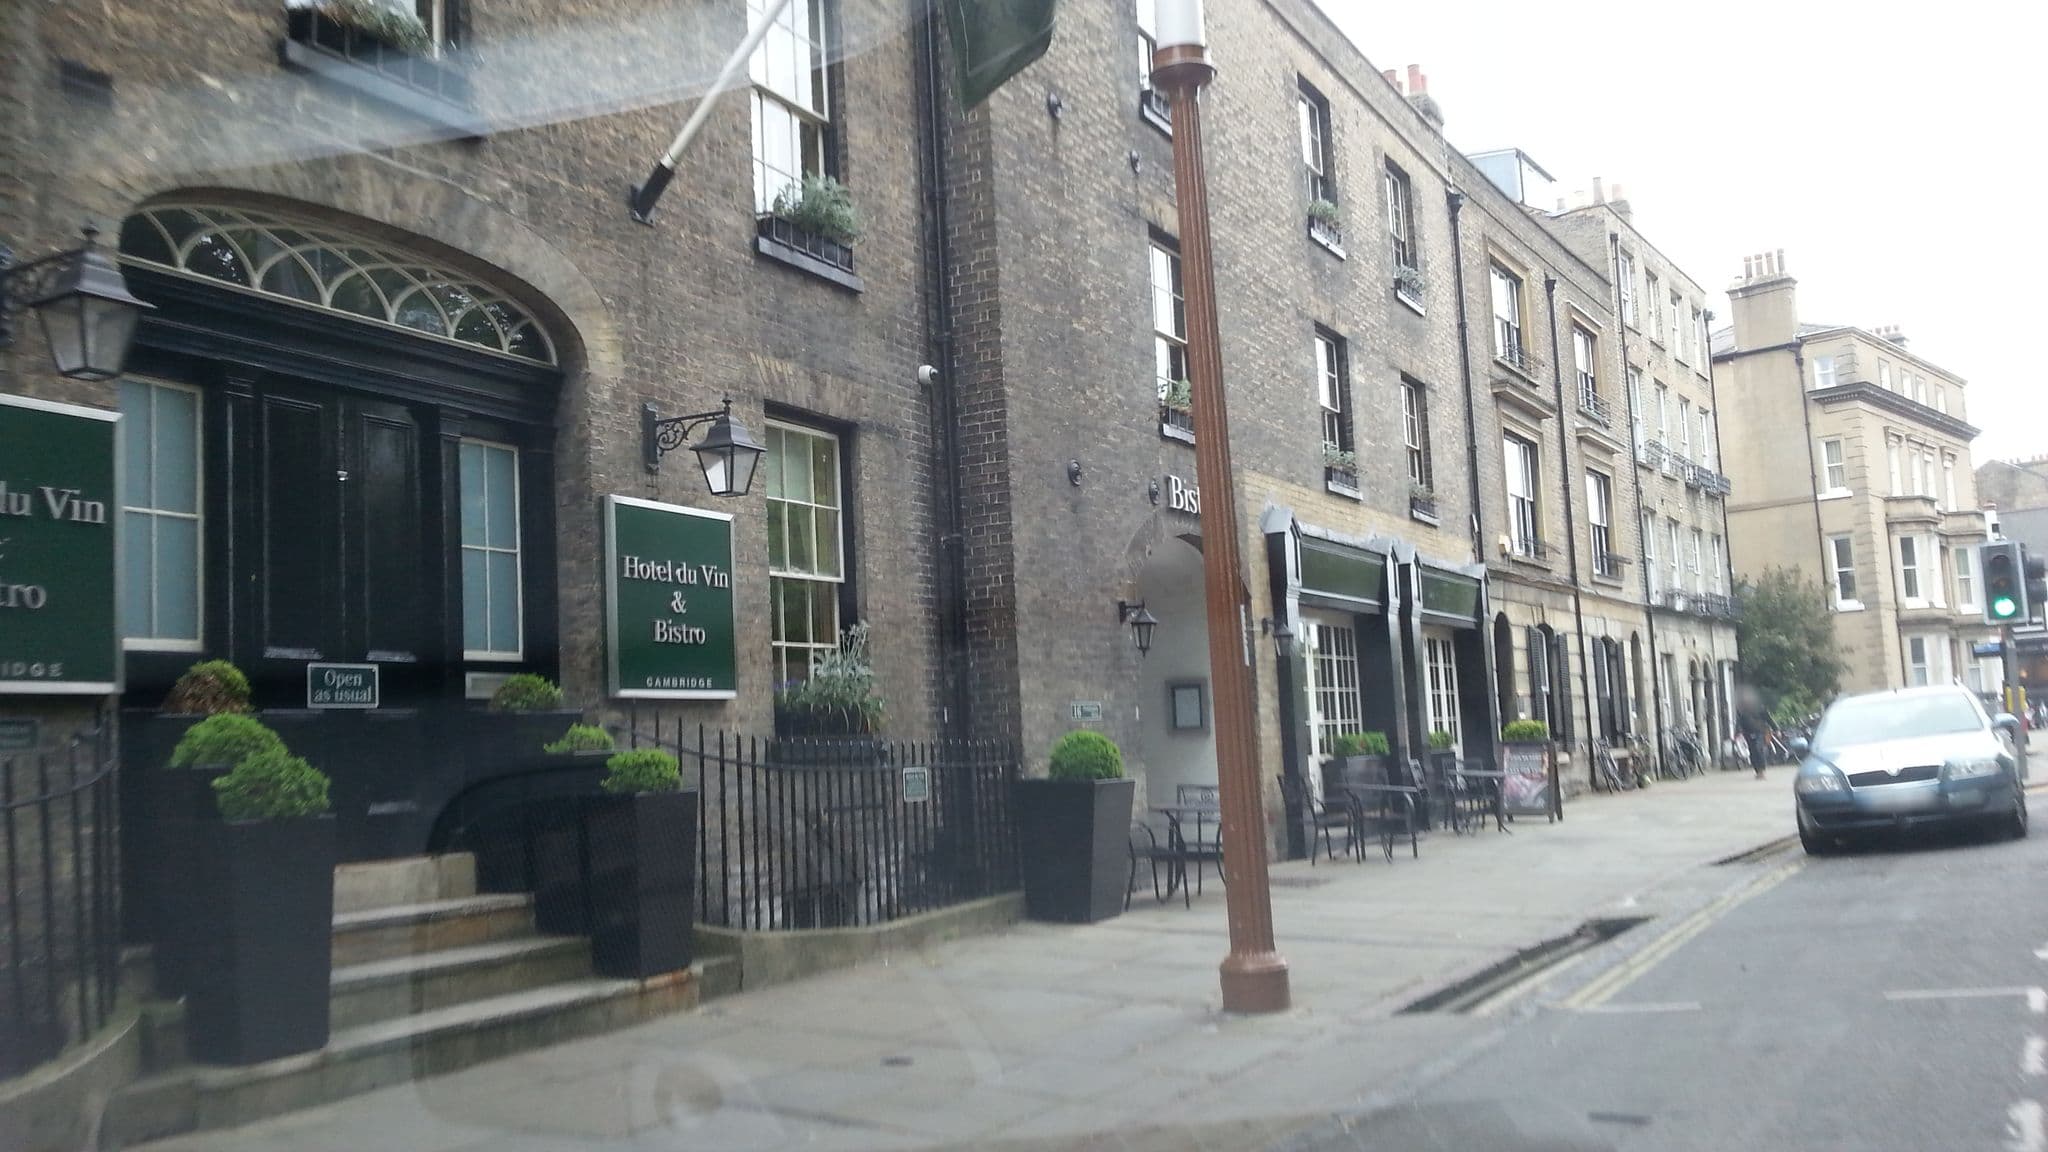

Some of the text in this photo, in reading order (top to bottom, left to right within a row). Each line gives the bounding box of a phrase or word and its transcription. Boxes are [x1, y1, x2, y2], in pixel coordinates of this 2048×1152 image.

[37, 486, 107, 524] Vin
[623, 555, 729, 589] Hotel du Vin
[671, 590, 687, 614] &
[653, 618, 706, 645] Bistro
[324, 669, 362, 689] Open
[646, 675, 713, 689] CAMBRIDGE
[313, 685, 372, 702] as usual
